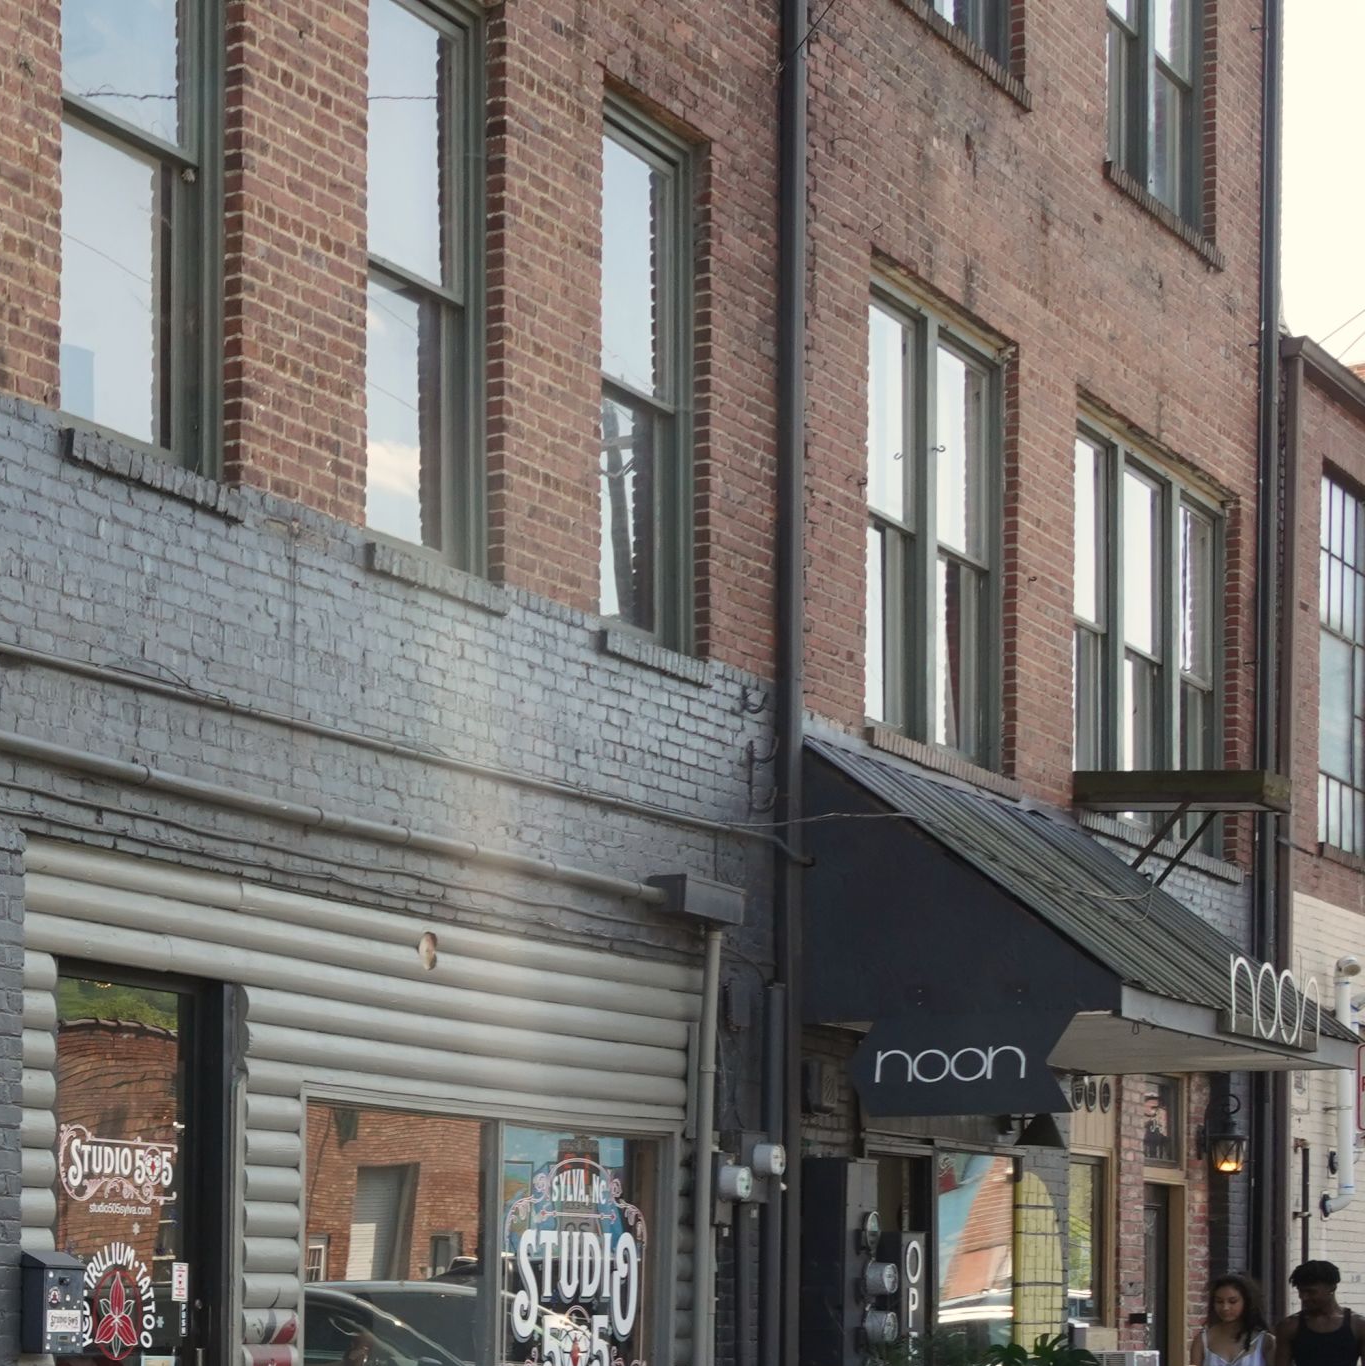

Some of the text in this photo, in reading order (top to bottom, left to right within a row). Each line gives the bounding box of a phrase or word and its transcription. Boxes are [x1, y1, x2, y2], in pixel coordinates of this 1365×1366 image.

[1230, 953, 1320, 1049] noon
[874, 1045, 1026, 1083] noon
[68, 1139, 132, 1187] STUDIO
[551, 1168, 609, 1206] SYLVA, NC
[89, 1203, 152, 1217] studio505sylva.com
[83, 1241, 136, 1290] TRILLIUM
[135, 1262, 156, 1349] TATTOO
[512, 1229, 638, 1340] STUDIO
